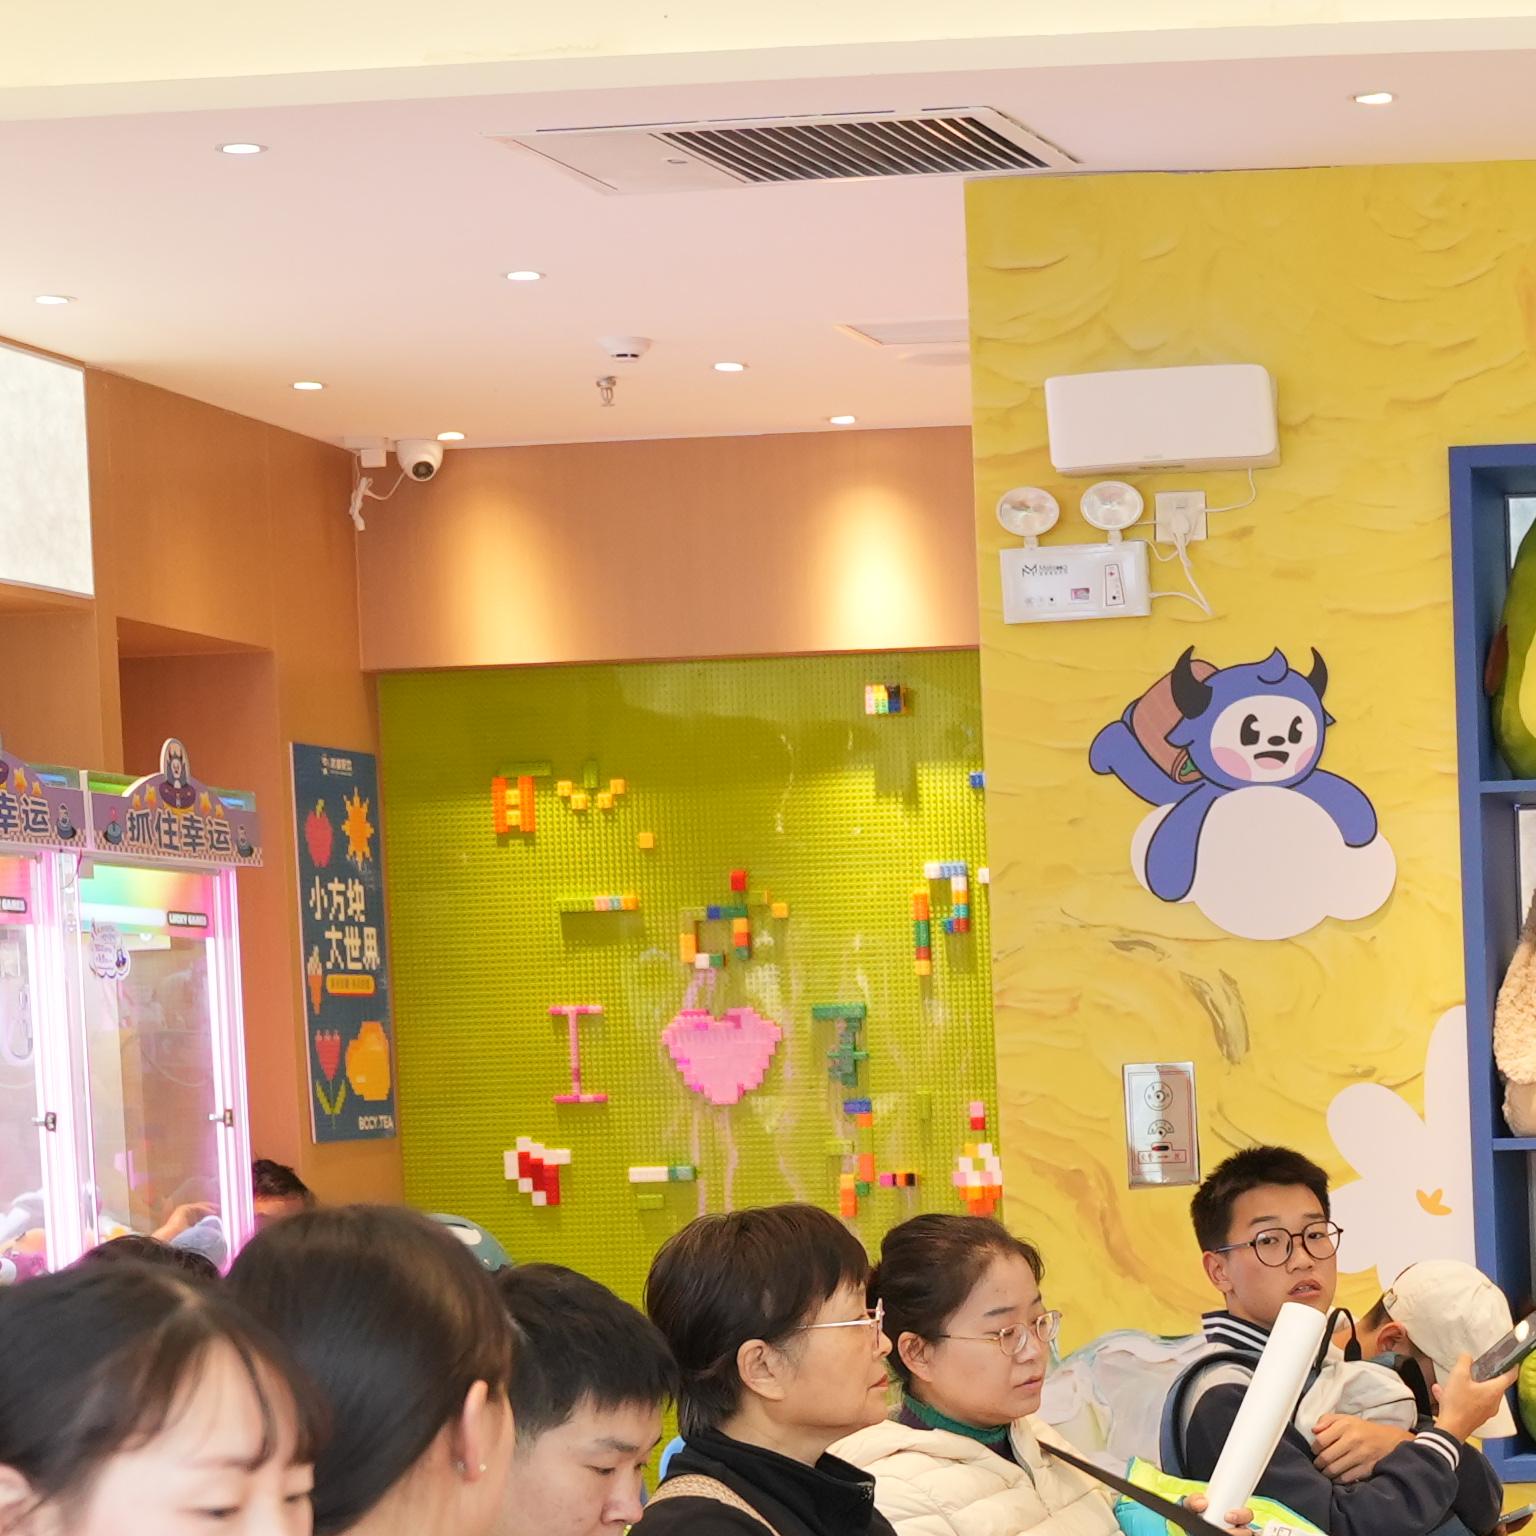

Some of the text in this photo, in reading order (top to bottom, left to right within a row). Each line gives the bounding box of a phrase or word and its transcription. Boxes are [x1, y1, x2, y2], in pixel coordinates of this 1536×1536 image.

[127, 808, 232, 853] 抓住幸运
[309, 875, 366, 923] 小方块
[325, 924, 381, 971] 大世界
